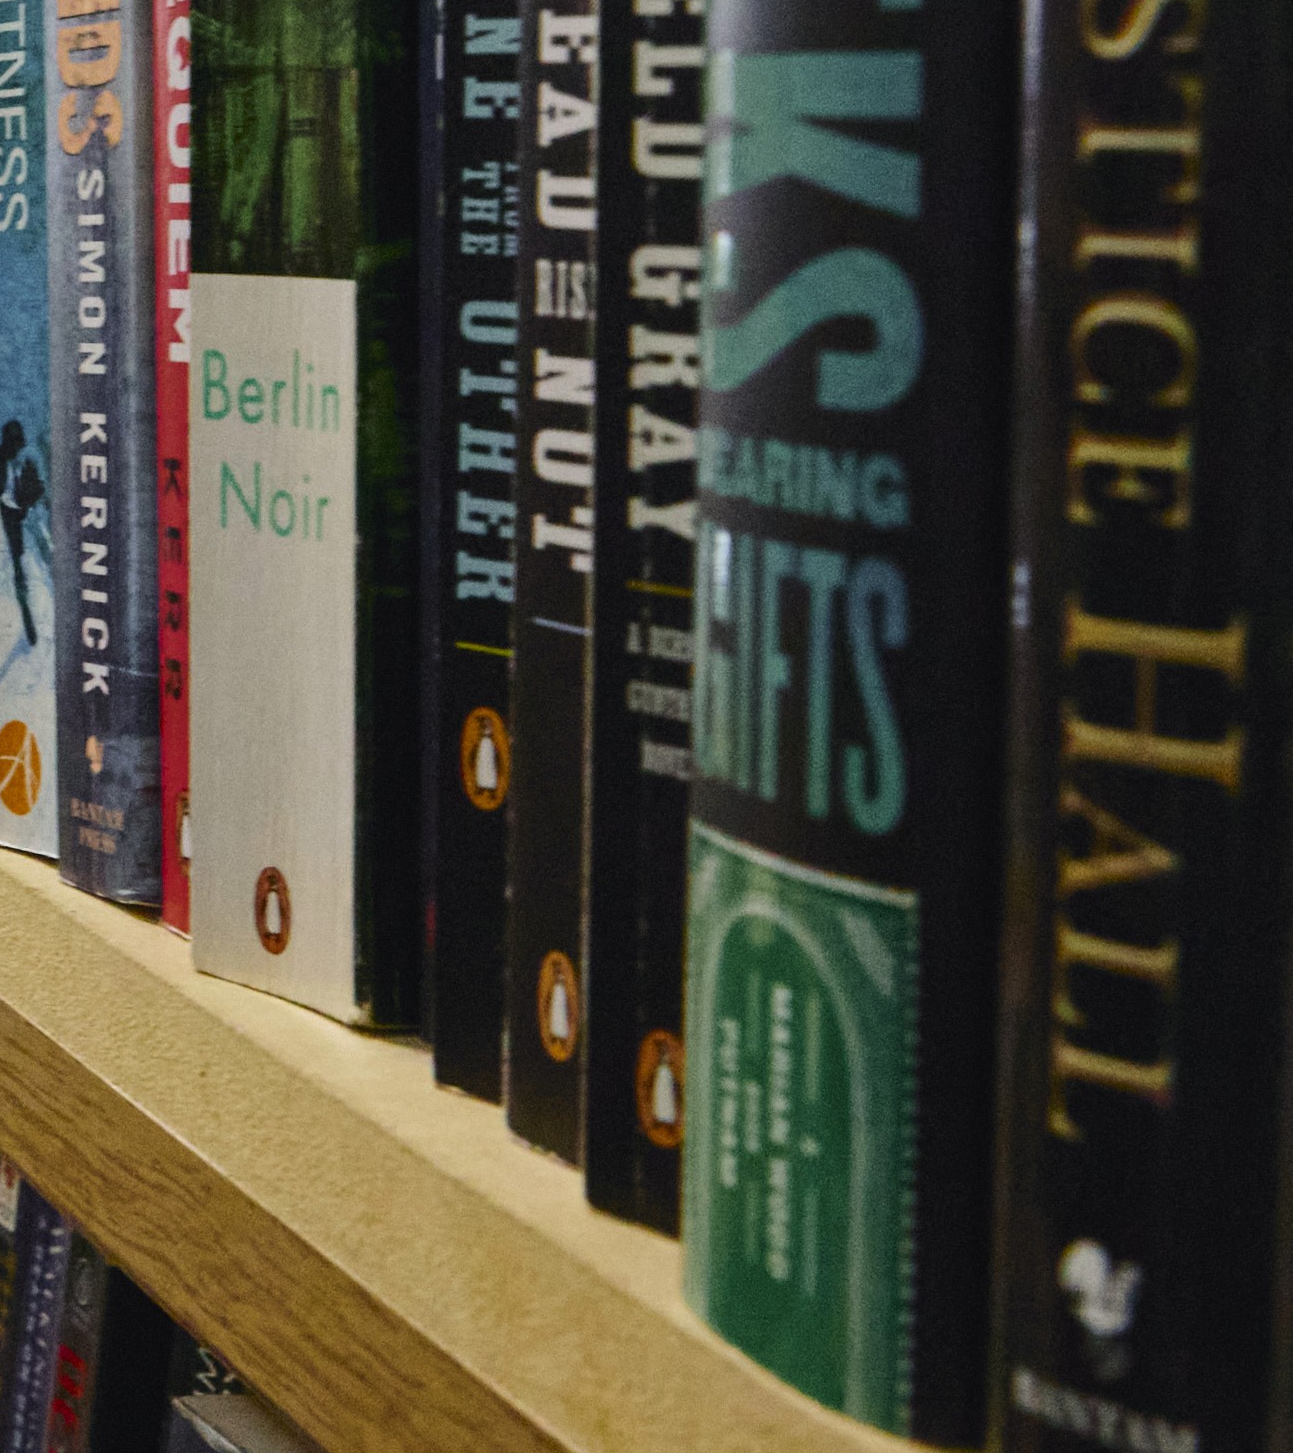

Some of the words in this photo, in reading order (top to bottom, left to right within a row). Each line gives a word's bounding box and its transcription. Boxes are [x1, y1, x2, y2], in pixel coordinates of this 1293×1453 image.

[77, 166, 109, 378] SIMON
[459, 160, 502, 258] THE
[201, 345, 343, 434] Berlin
[219, 459, 331, 543] Noir
[455, 299, 519, 603] OTHER
[532, 346, 597, 575] NOT
[626, 243, 706, 543] GRAY
[78, 409, 111, 697] KERNICK
[162, 456, 184, 703] KERR
[1049, 593, 1247, 1147] HALL
